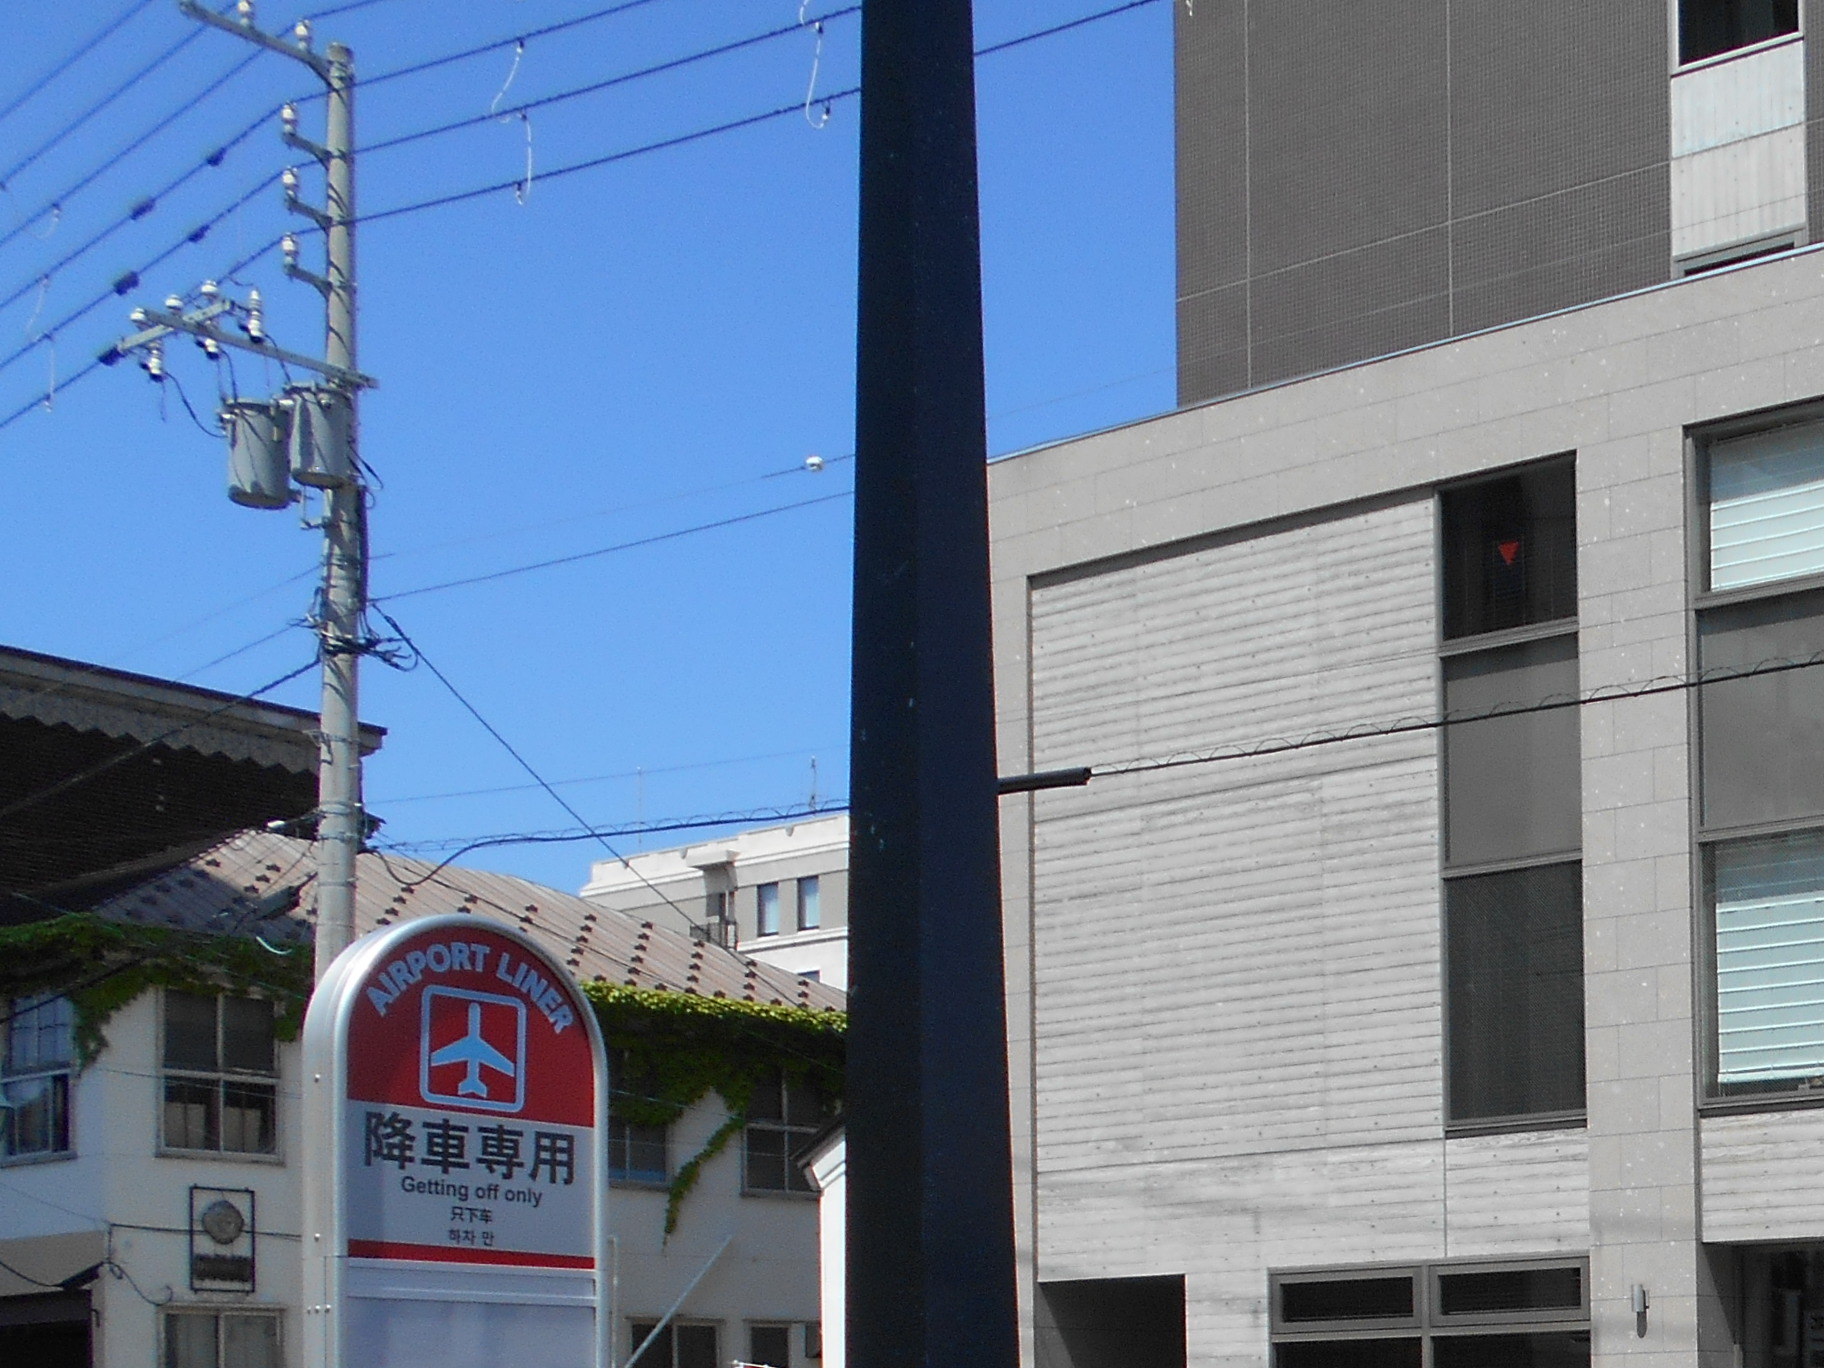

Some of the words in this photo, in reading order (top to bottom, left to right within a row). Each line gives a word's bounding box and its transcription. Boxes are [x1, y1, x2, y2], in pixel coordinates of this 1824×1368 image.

[367, 942, 490, 1017] AIRPORT
[496, 953, 575, 1034] LINER
[364, 1110, 576, 1186] 降車専用
[401, 1175, 469, 1201] Getting
[476, 1183, 501, 1200] off
[504, 1186, 543, 1208] only
